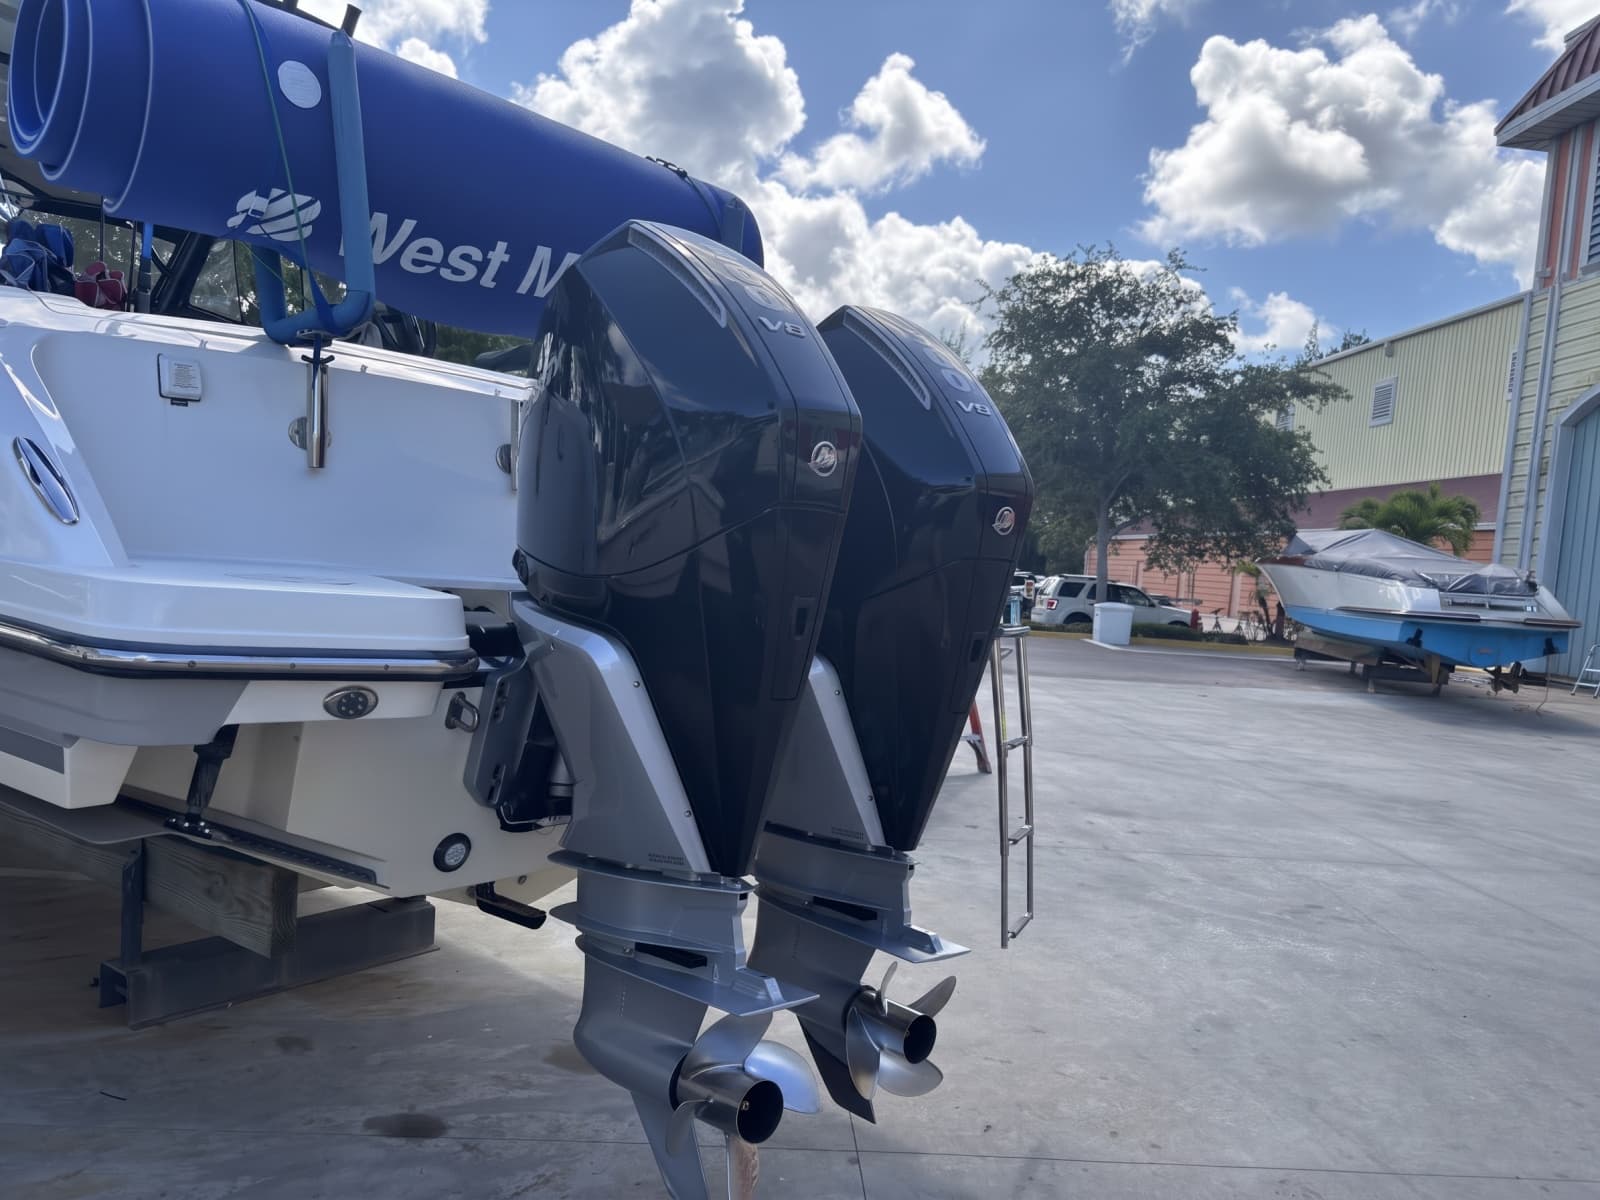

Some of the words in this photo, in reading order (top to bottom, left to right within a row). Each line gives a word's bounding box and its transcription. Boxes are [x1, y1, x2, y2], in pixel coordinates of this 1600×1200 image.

[338, 211, 511, 289] West
[758, 316, 806, 338] V8
[956, 400, 992, 417] V8
